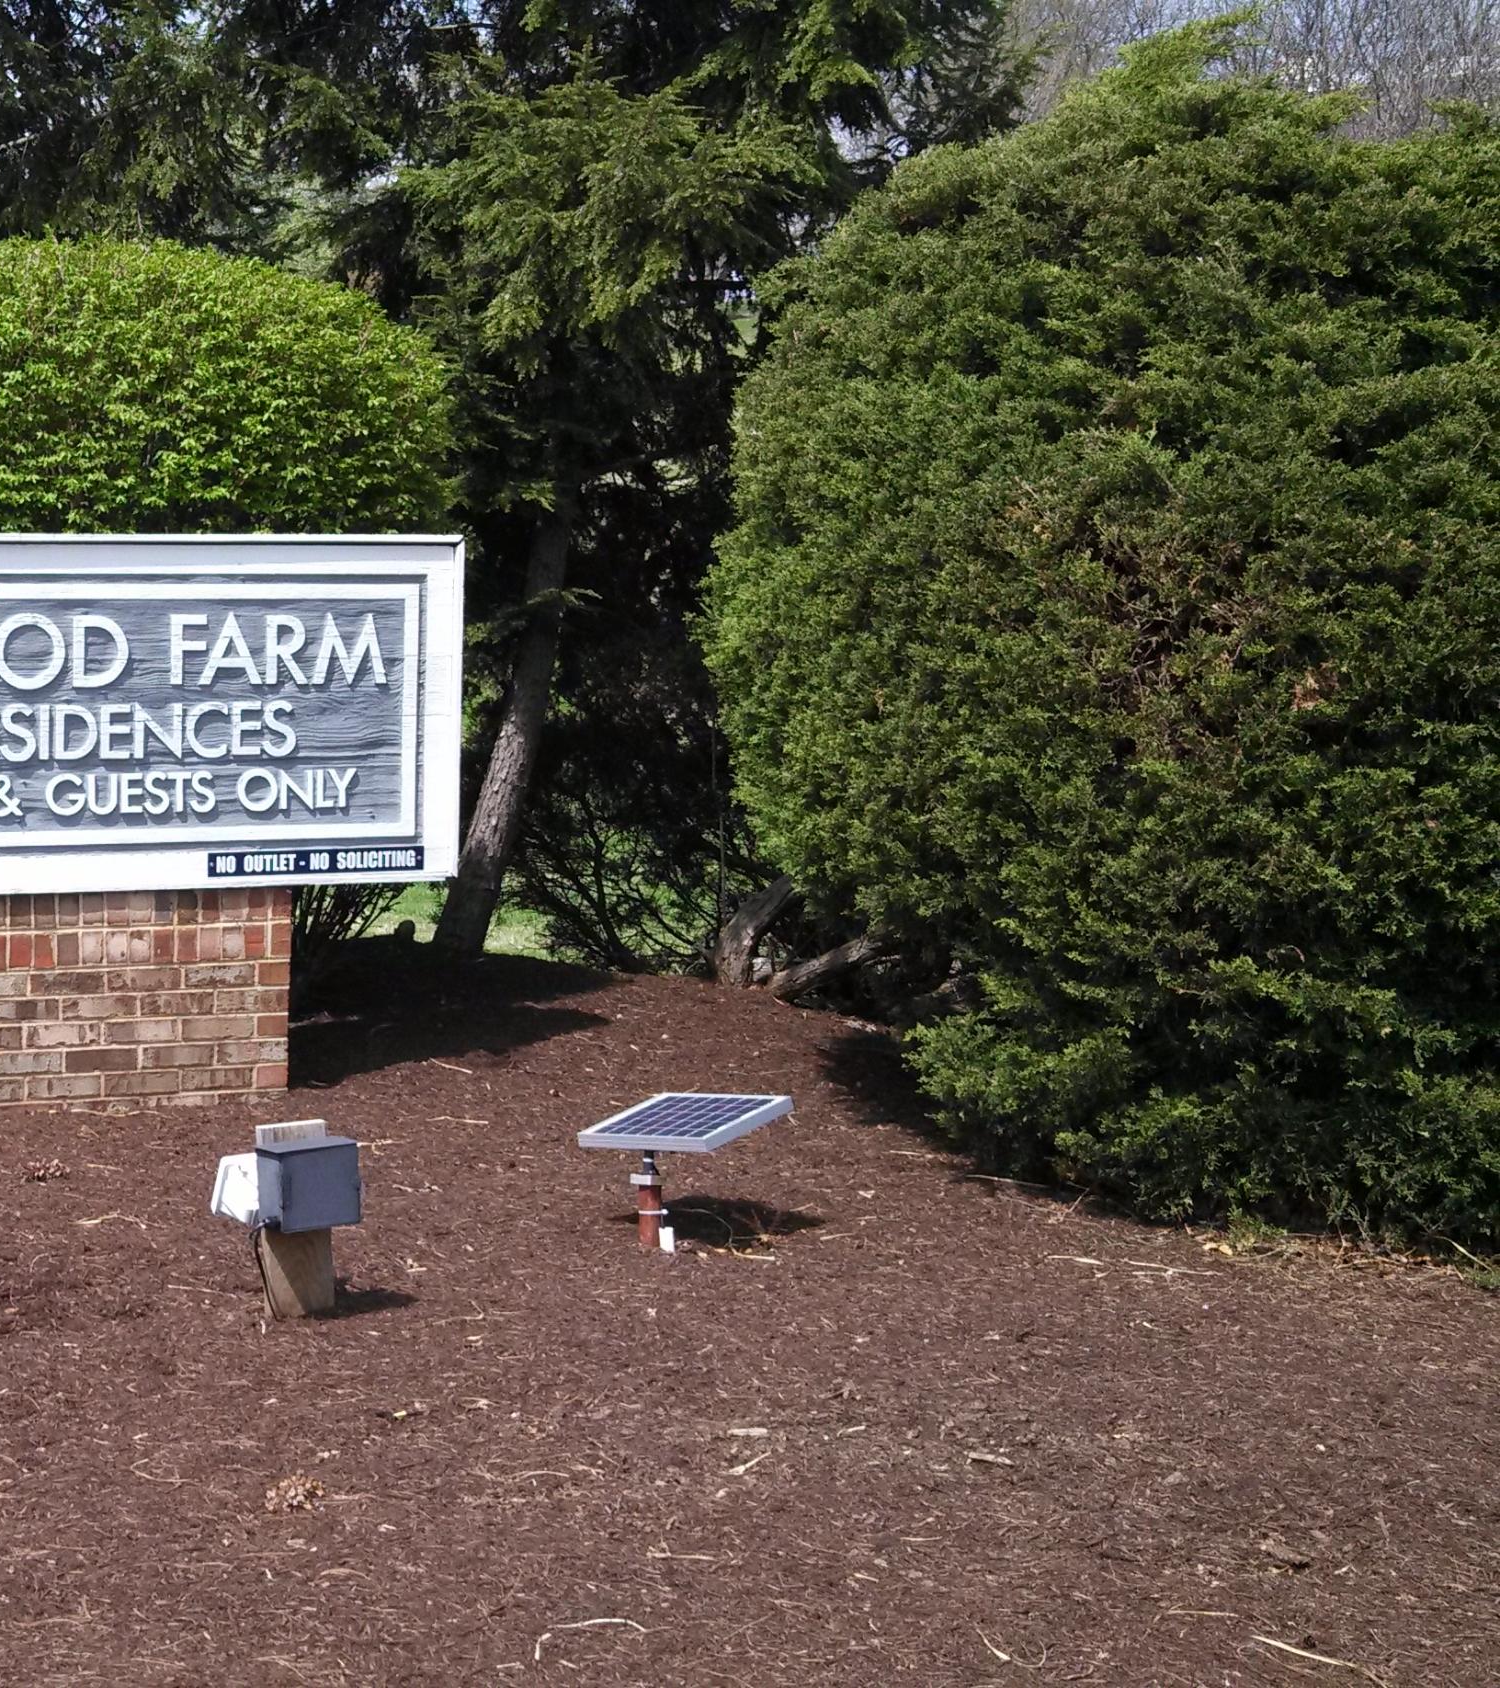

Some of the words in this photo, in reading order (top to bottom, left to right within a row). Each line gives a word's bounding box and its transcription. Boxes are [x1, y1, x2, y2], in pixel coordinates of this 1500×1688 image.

[169, 611, 388, 686] FARM
[45, 770, 216, 816] GUESTS
[237, 767, 357, 812] ONLY
[214, 855, 237, 874] NO
[243, 853, 297, 873] OUTLET
[309, 852, 330, 871] NO
[336, 849, 417, 870] SOLICITING
